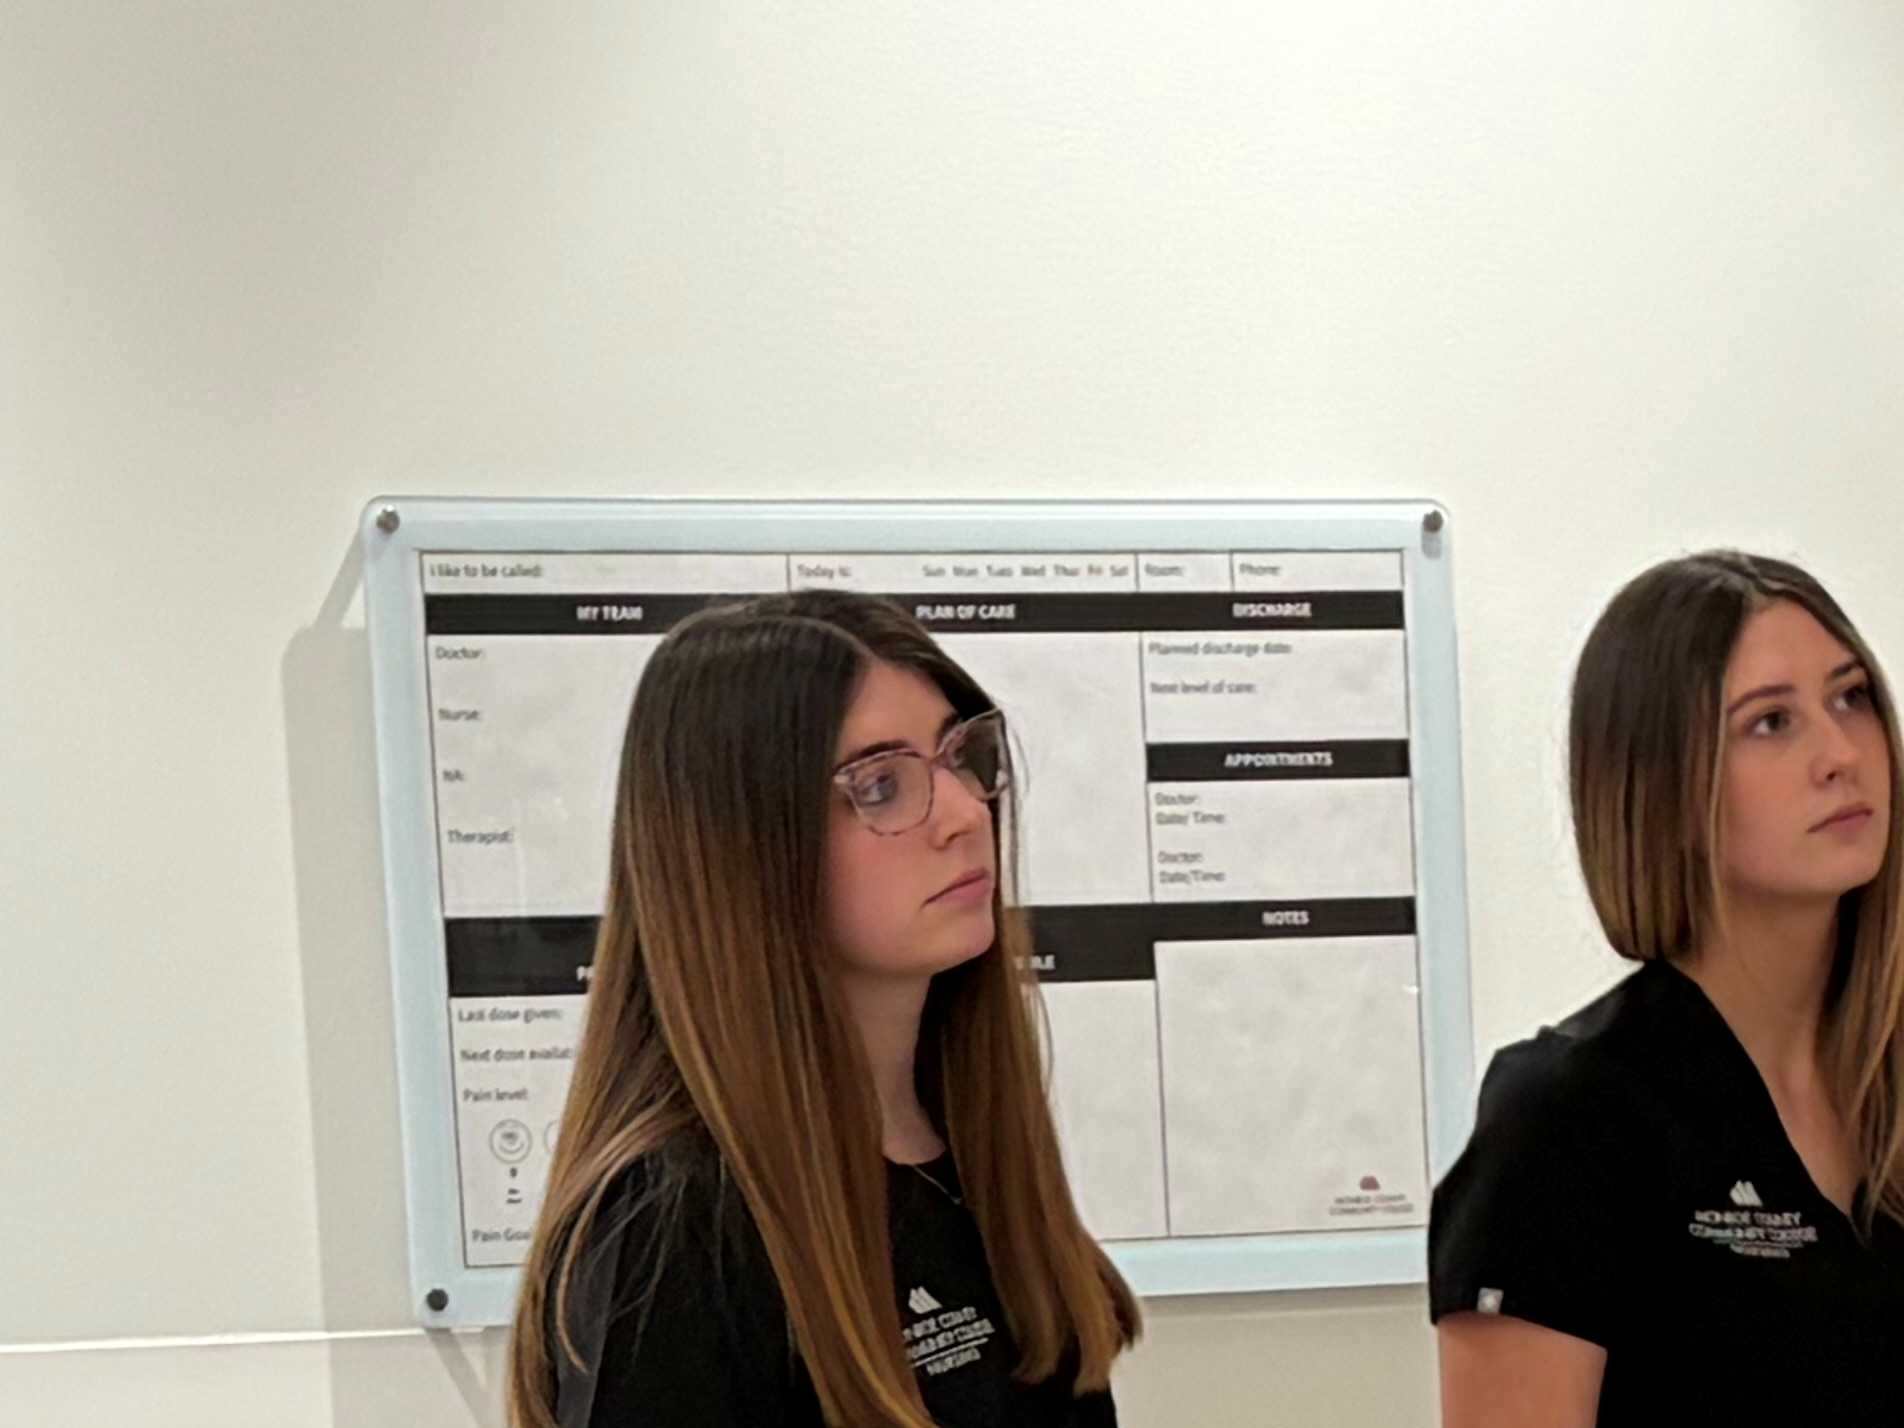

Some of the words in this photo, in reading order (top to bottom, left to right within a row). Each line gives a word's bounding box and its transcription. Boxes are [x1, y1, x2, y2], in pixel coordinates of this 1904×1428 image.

[463, 564, 478, 577] to
[481, 563, 497, 577] be
[797, 565, 834, 579] Today
[576, 606, 598, 620] MY
[602, 605, 643, 621] TEAM
[916, 605, 954, 619] PLAN
[957, 604, 976, 619] OF
[979, 604, 1015, 619] CARE
[1233, 603, 1312, 617] DISCHARGE
[1224, 752, 1333, 767] APPOINTMENTS
[1262, 911, 1309, 925] NOTES
